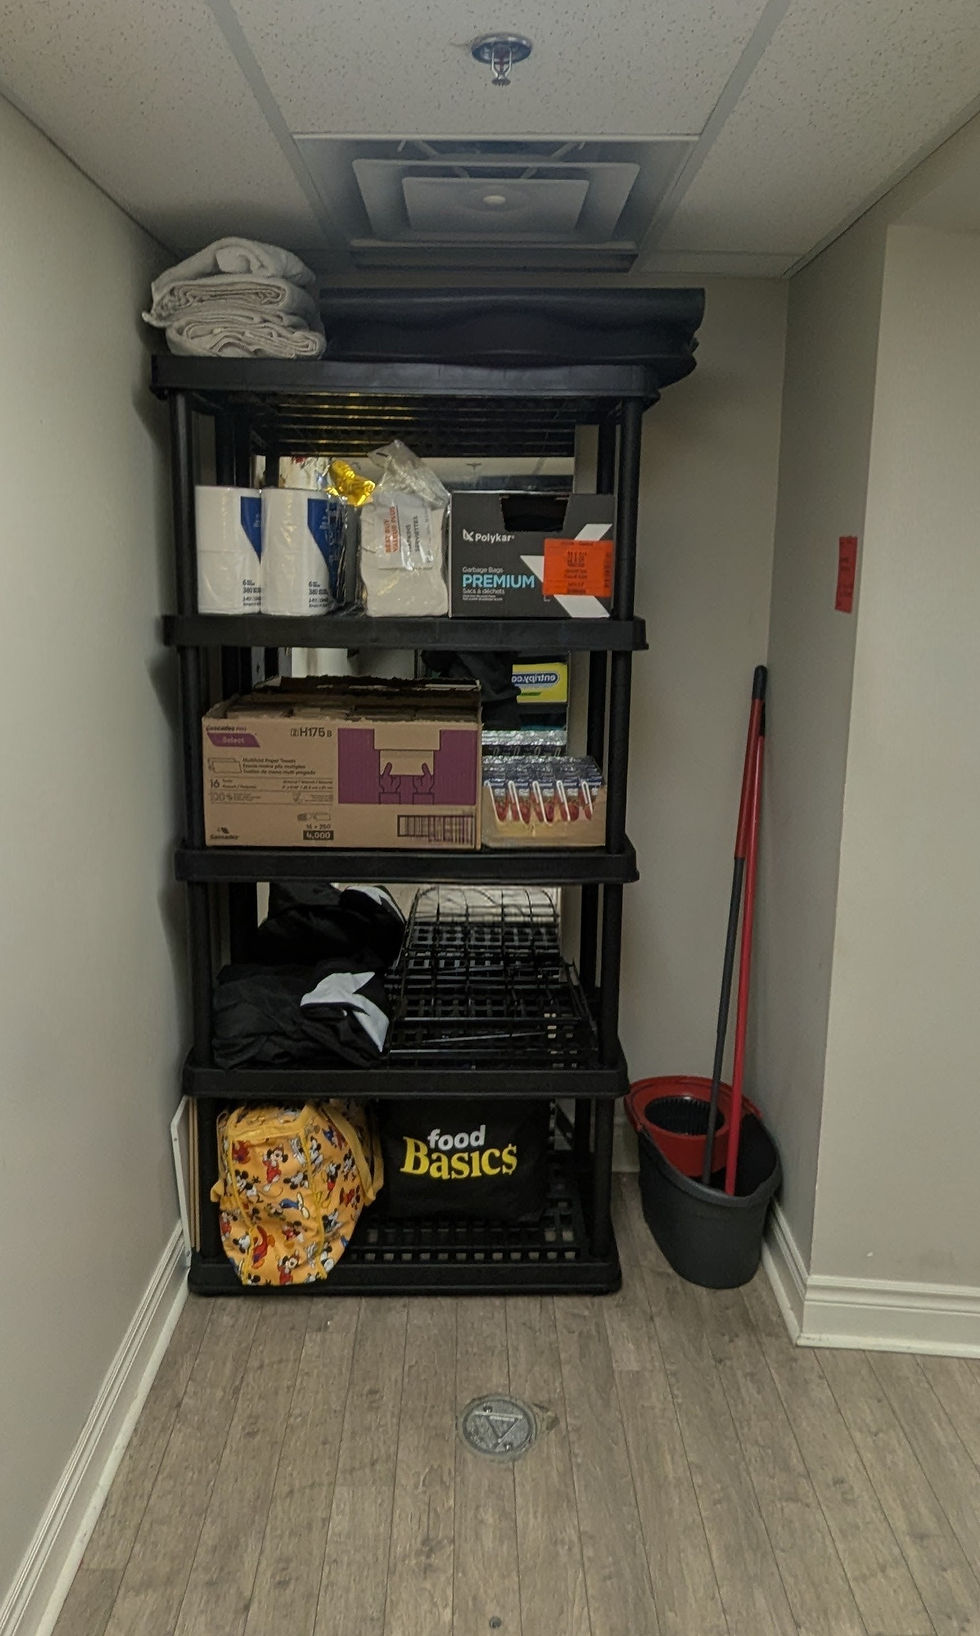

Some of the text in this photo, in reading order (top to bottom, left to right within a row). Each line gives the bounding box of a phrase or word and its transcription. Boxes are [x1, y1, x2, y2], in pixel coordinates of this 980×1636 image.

[475, 532, 512, 544] Polykar
[462, 566, 503, 574] Garbage Bags
[462, 575, 535, 588] PREMIUM
[210, 779, 220, 788] 16
[427, 1124, 486, 1150] food
